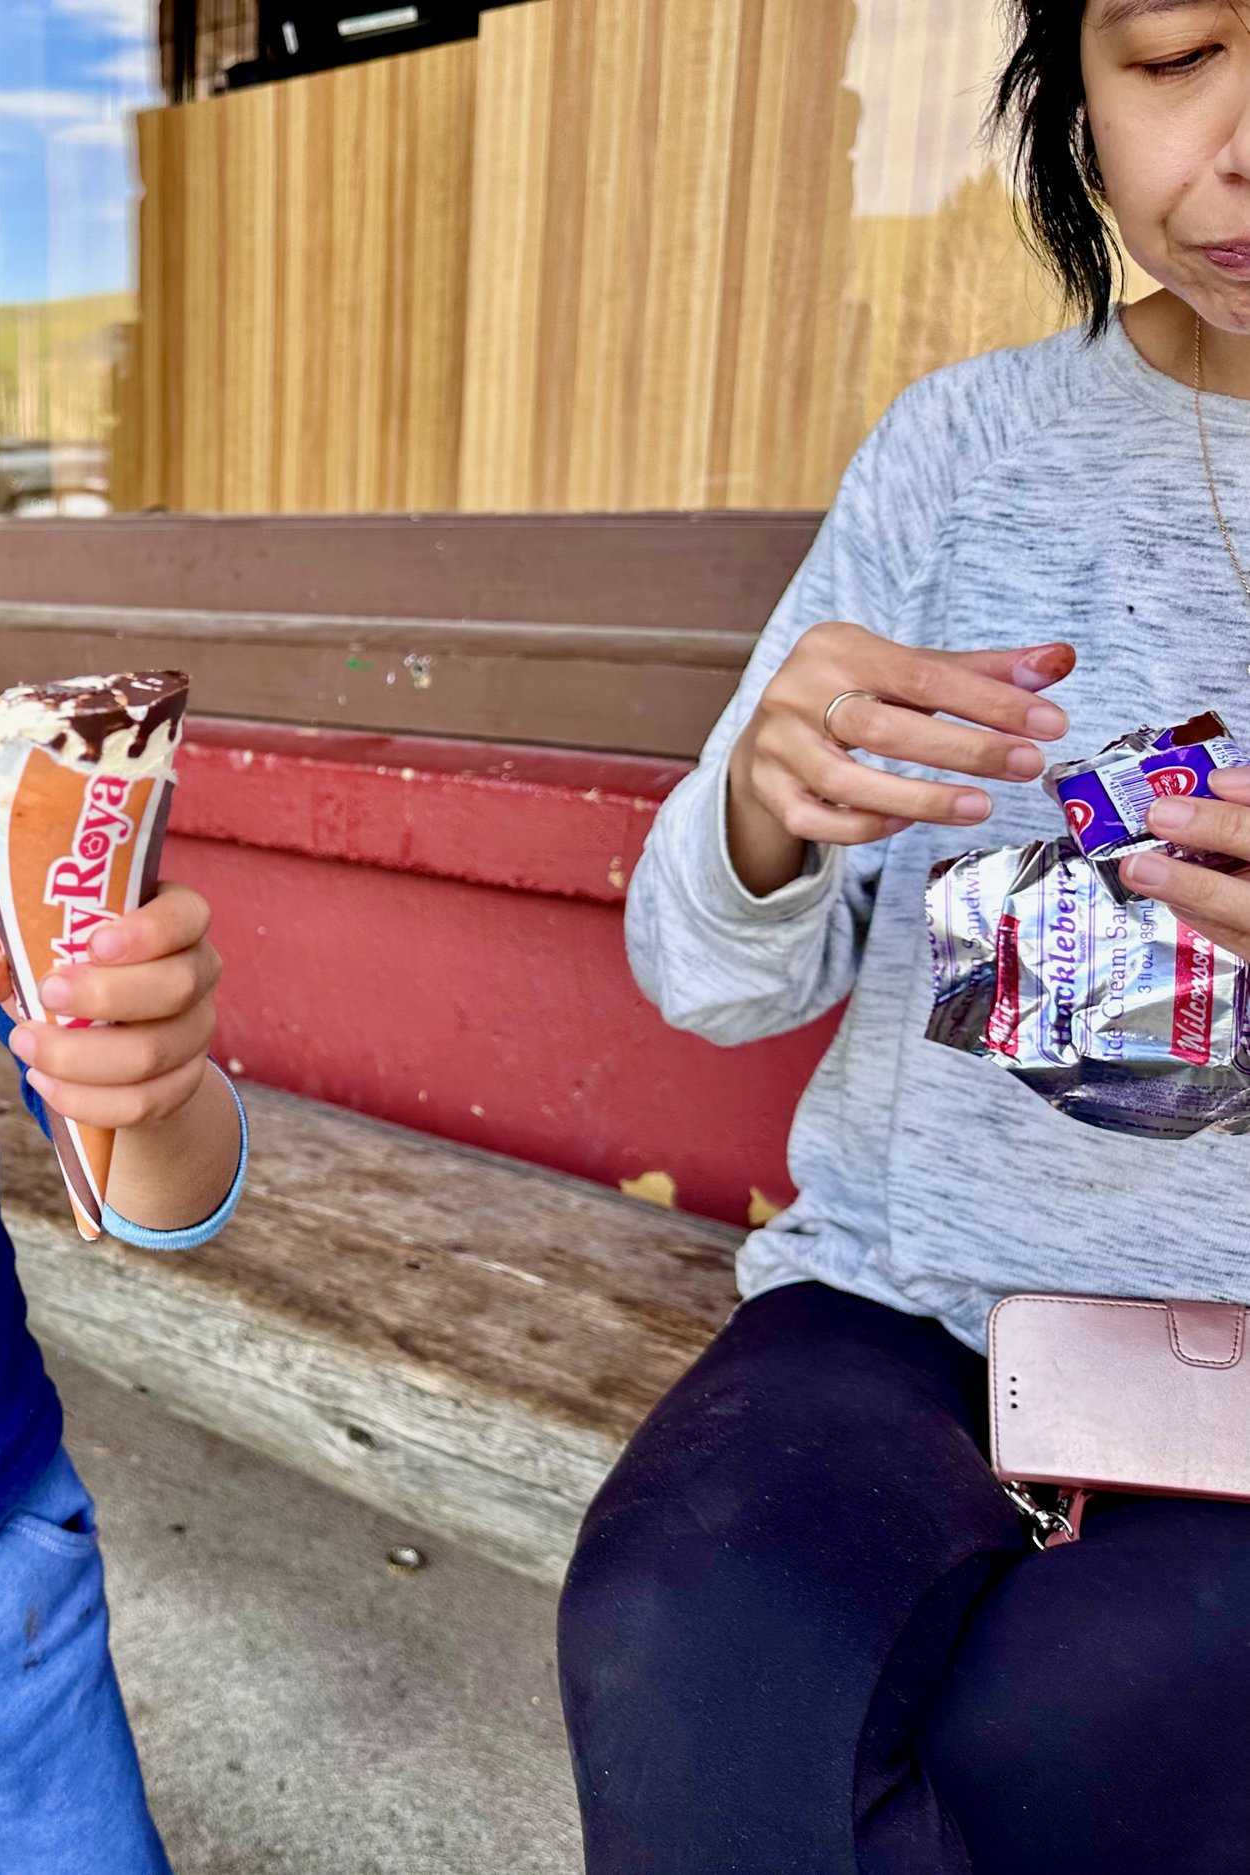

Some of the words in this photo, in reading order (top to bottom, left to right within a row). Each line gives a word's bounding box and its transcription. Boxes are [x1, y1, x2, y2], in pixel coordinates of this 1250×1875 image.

[1140, 900, 1156, 944] (89mL
[1102, 948, 1127, 1020] Cream
[1138, 985, 1151, 994] 3
[1176, 930, 1212, 1053] Wilcoxson'
[1104, 1027, 1124, 1059] Ice
